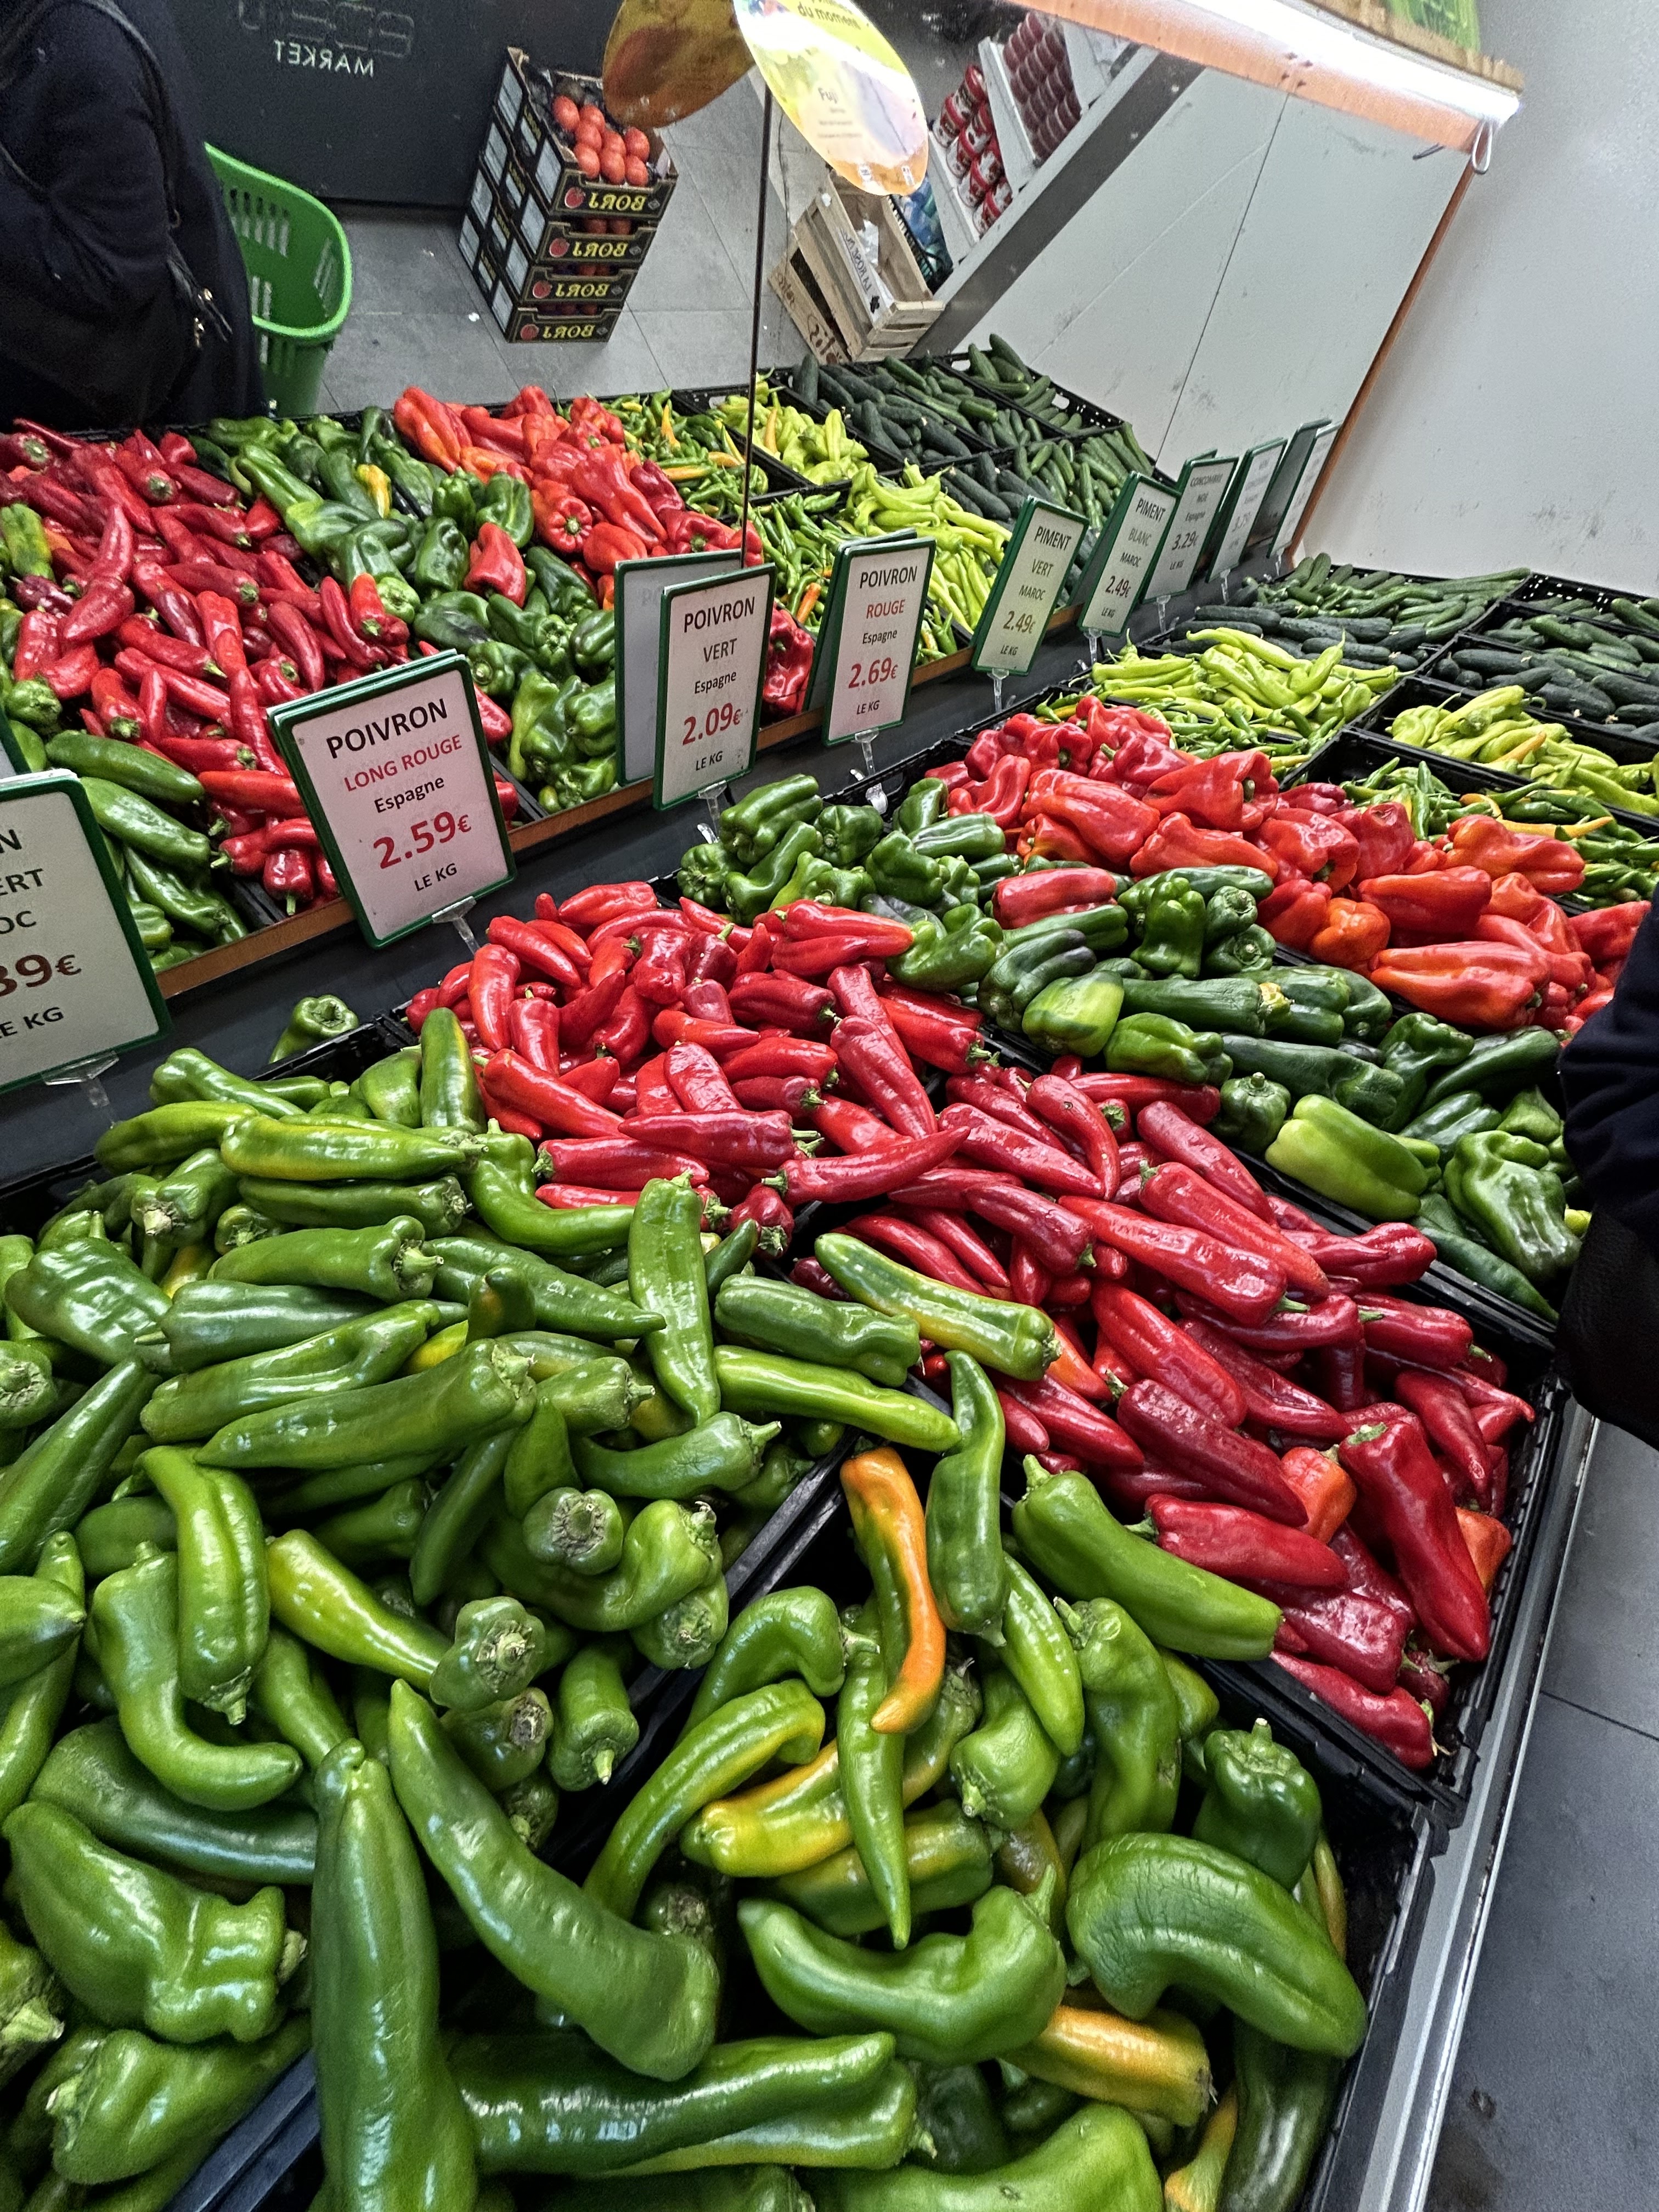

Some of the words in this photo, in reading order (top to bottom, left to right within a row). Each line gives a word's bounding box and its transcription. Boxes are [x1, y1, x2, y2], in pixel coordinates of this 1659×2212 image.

[1136, 498, 1166, 522] PIMENT
[1034, 526, 1071, 551] PIMENT
[1128, 528, 1152, 548] BLANC
[1032, 559, 1054, 577] VERT
[1120, 552, 1142, 568] MAROC
[860, 566, 918, 589] POIVRON
[1105, 575, 1131, 597] 2.49€
[1019, 585, 1046, 601] MAROC
[684, 596, 755, 633] POIVRON
[866, 599, 905, 619] ROUGE
[1003, 611, 1036, 635] 2.49€
[862, 630, 898, 646] Espagne
[703, 638, 737, 663] VERT
[1000, 645, 1008, 654] LE
[1008, 646, 1018, 656] KG
[695, 671, 737, 694] Espagne
[848, 657, 899, 689] 2.69€
[856, 703, 866, 715] LE
[867, 699, 879, 713] KG
[326, 698, 448, 759] POIVRON
[682, 702, 741, 746] 2.09€
[344, 760, 398, 792] LONG
[402, 735, 462, 770] ROUGE
[696, 757, 707, 771] LE
[709, 751, 723, 767] KG
[374, 777, 445, 814] Espagne
[373, 811, 472, 870] 2.59€
[414, 874, 432, 892] LE
[436, 863, 457, 883] KG
[0, 1021, 18, 1039] E
[23, 1007, 64, 1029] KG
